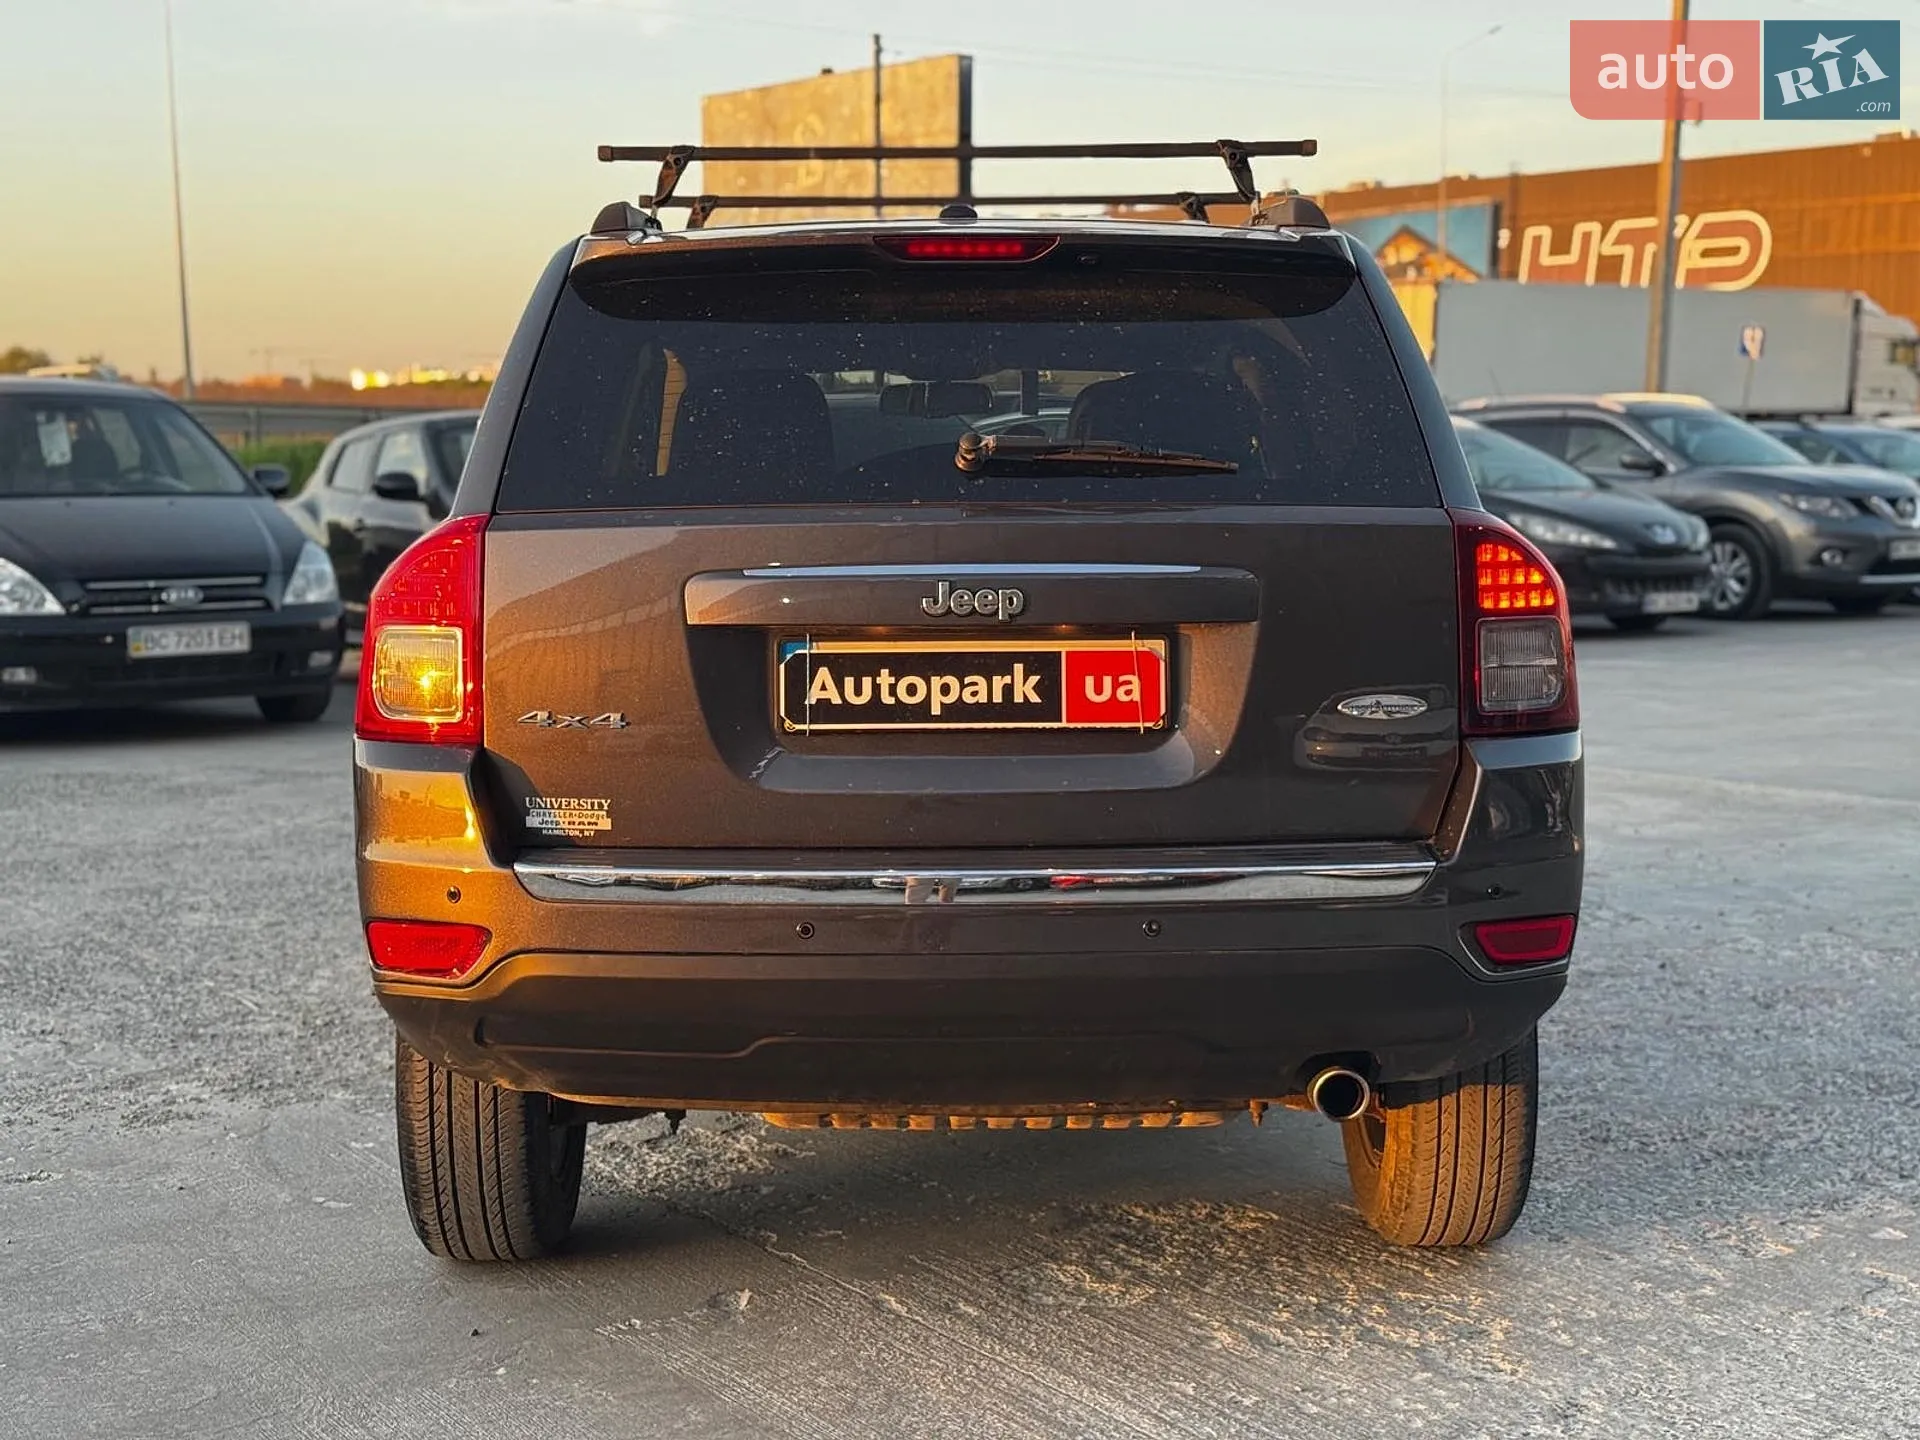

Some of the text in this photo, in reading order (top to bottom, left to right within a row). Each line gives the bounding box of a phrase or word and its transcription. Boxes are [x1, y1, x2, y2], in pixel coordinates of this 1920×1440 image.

[921, 580, 1025, 621] Jeep
[805, 663, 1141, 715] Autopark ua
[518, 710, 632, 729] 4x4
[525, 796, 611, 810] UNIVERSITY
[538, 818, 561, 827] Jeep
